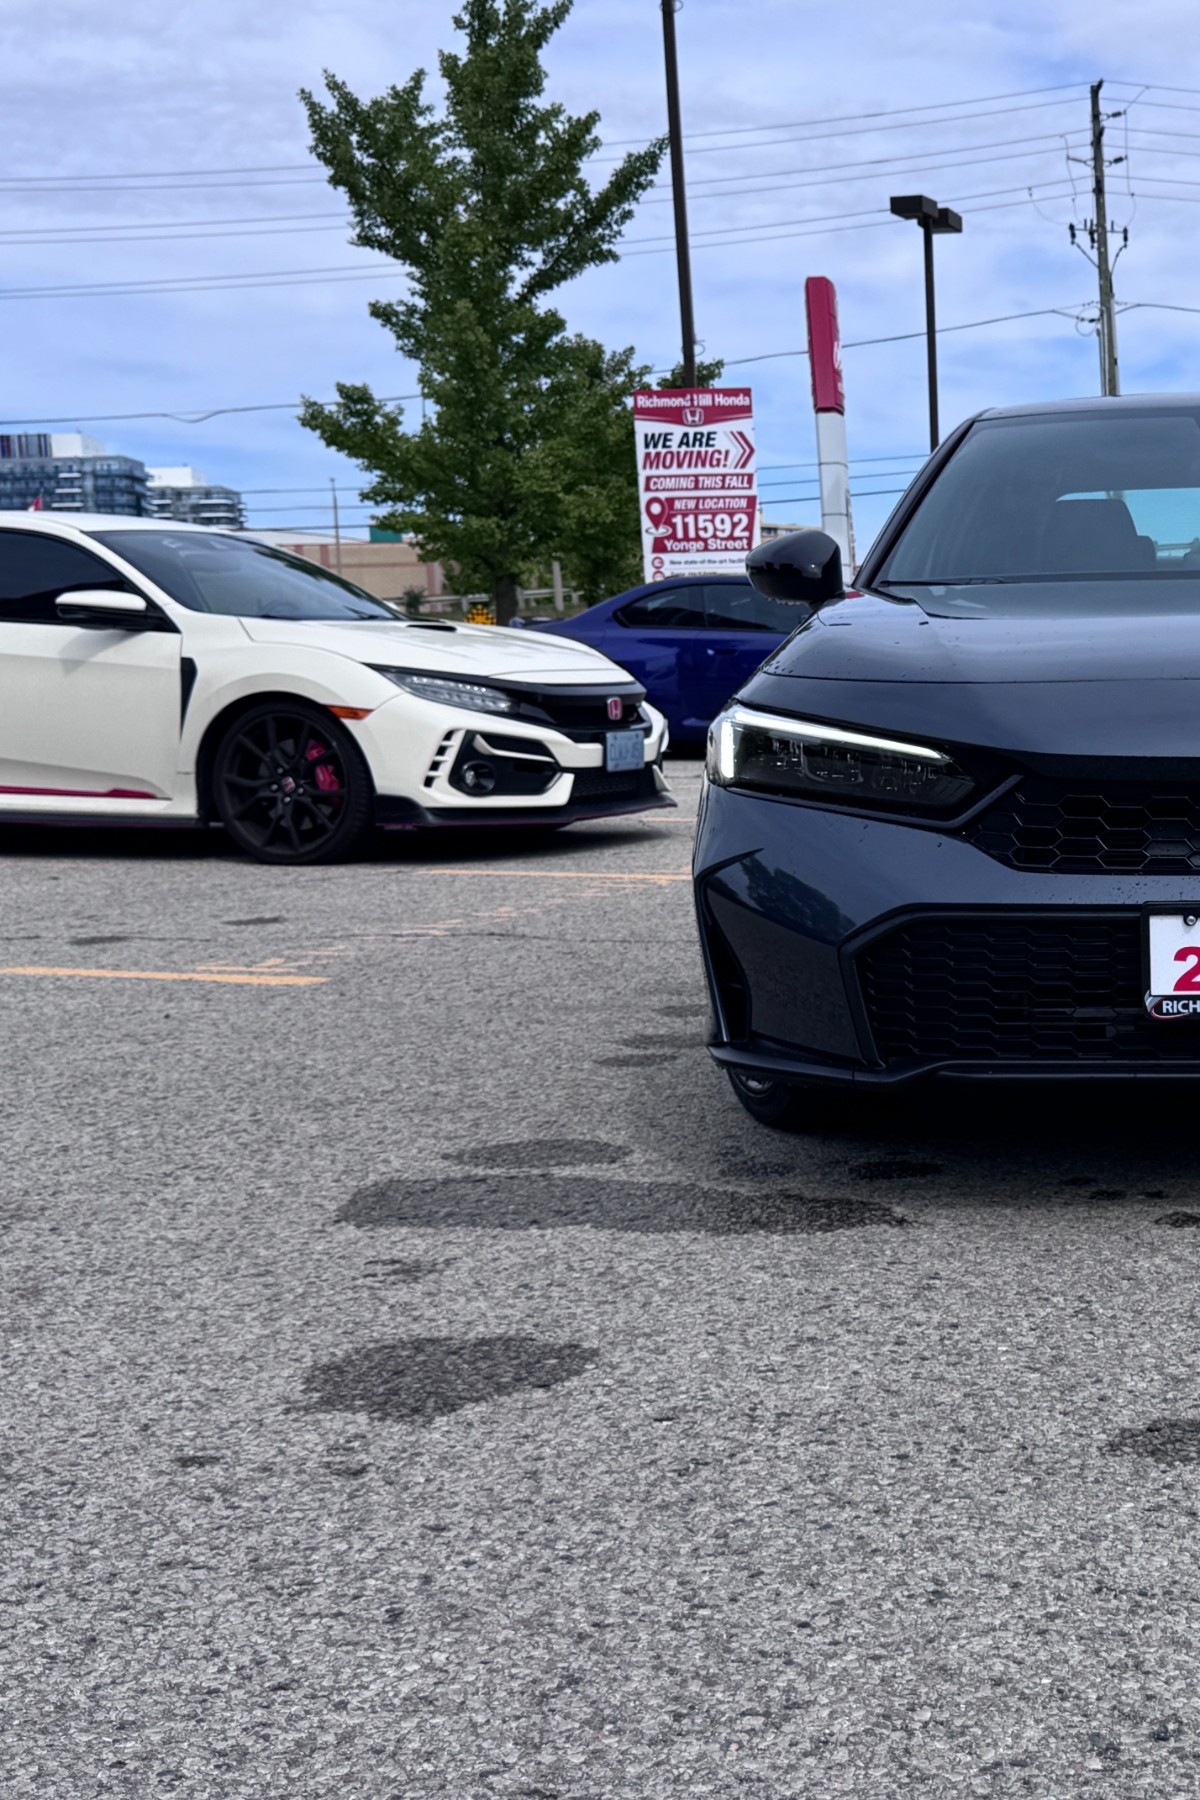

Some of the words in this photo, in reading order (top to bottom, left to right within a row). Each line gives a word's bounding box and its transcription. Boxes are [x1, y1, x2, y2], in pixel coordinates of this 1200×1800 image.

[637, 394, 690, 408] Richmond
[694, 393, 712, 406] Hill
[714, 393, 750, 406] Honda
[644, 432, 673, 449] WE
[678, 431, 717, 448] ARE
[642, 449, 729, 470] MOVING!
[650, 477, 695, 490] COMING
[698, 476, 722, 489] THIS
[725, 475, 749, 488] FALL
[674, 499, 697, 510] NEW
[699, 498, 747, 509] LOCATION
[671, 513, 750, 538] 11592
[664, 539, 705, 553] Yonge
[707, 537, 748, 550] Street
